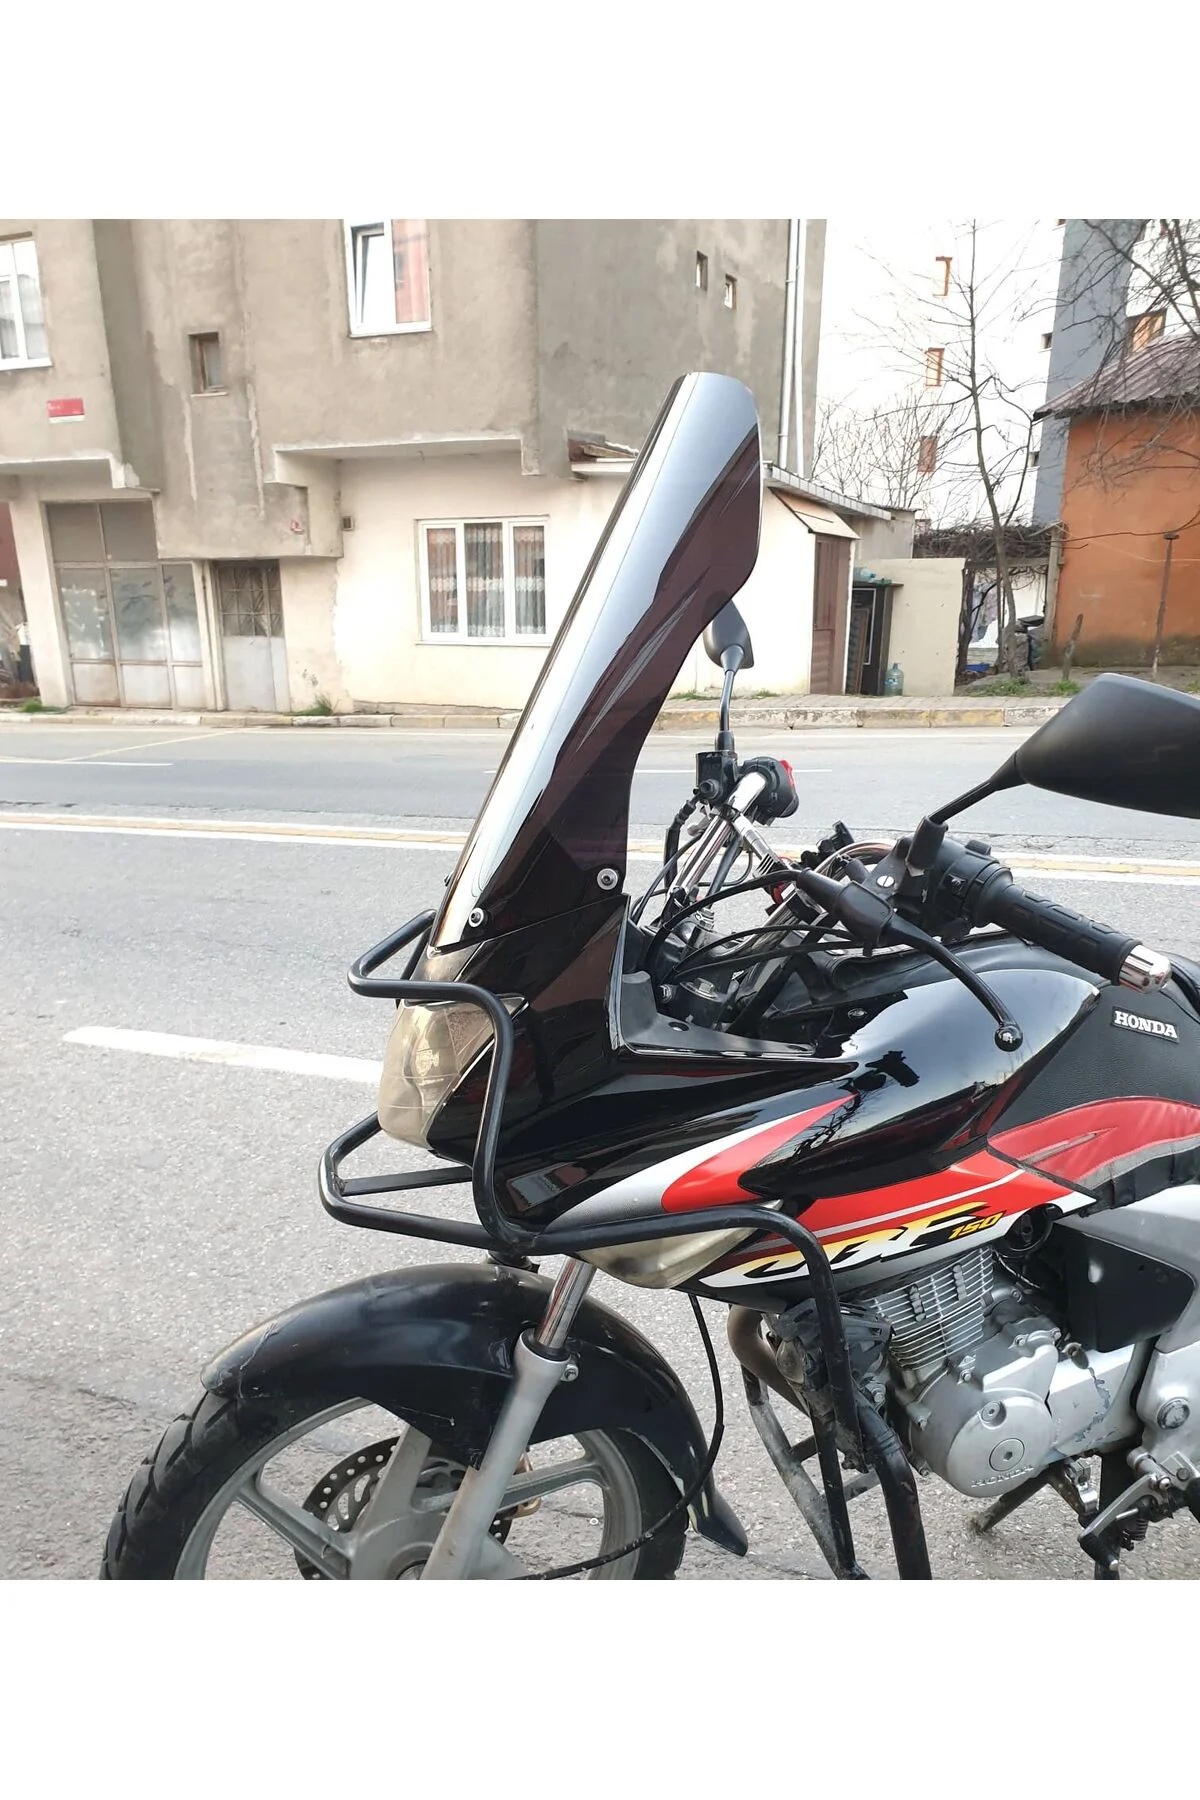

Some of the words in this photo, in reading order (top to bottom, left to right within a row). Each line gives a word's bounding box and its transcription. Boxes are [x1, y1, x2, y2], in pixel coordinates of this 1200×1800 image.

[1114, 1010, 1178, 1039] HONDA
[947, 1210, 1006, 1241] 150
[970, 1464, 1035, 1488] HONDA
